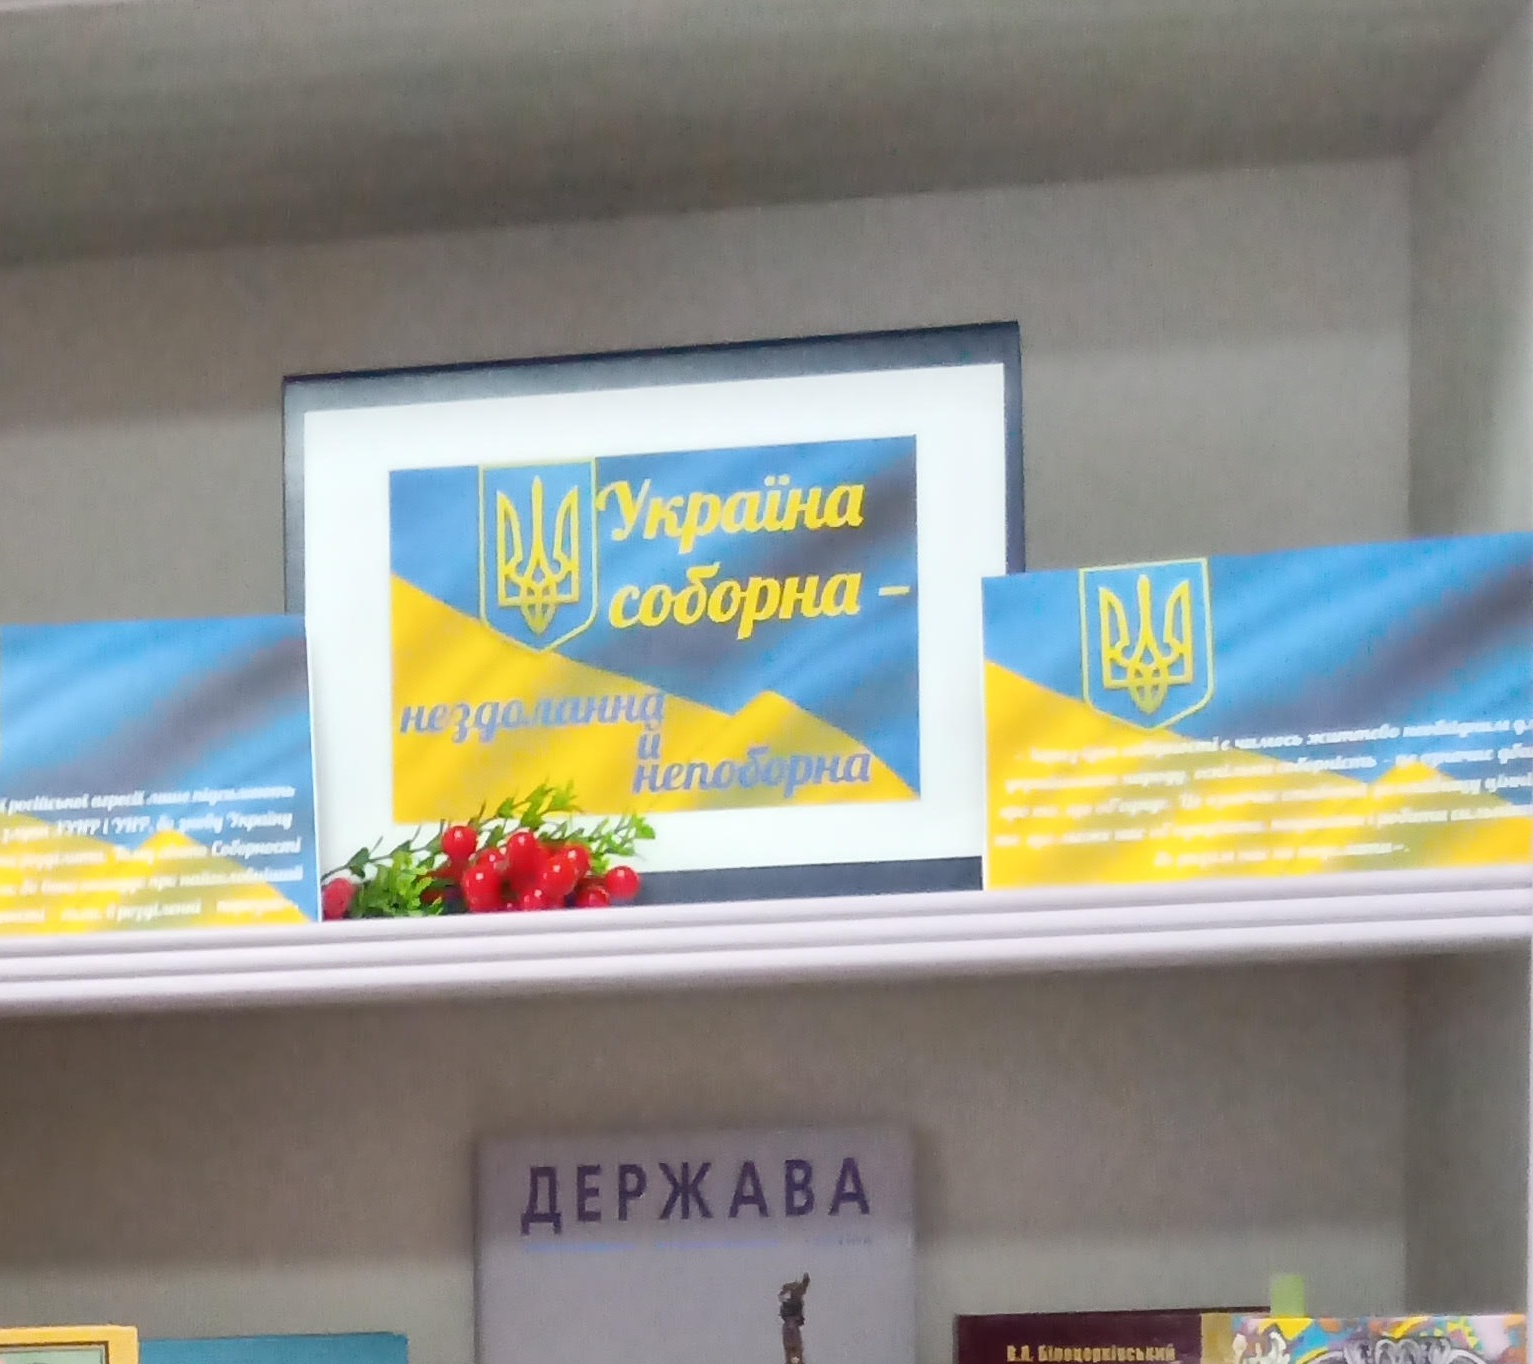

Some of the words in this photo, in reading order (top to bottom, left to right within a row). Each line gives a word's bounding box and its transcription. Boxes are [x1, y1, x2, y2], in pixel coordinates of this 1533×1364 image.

[596, 475, 865, 555] Україна
[609, 561, 861, 641] соборна
[400, 690, 667, 744] нездоланна
[631, 747, 871, 799] непоборна
[521, 1157, 871, 1236] ДЕРЖАВА
